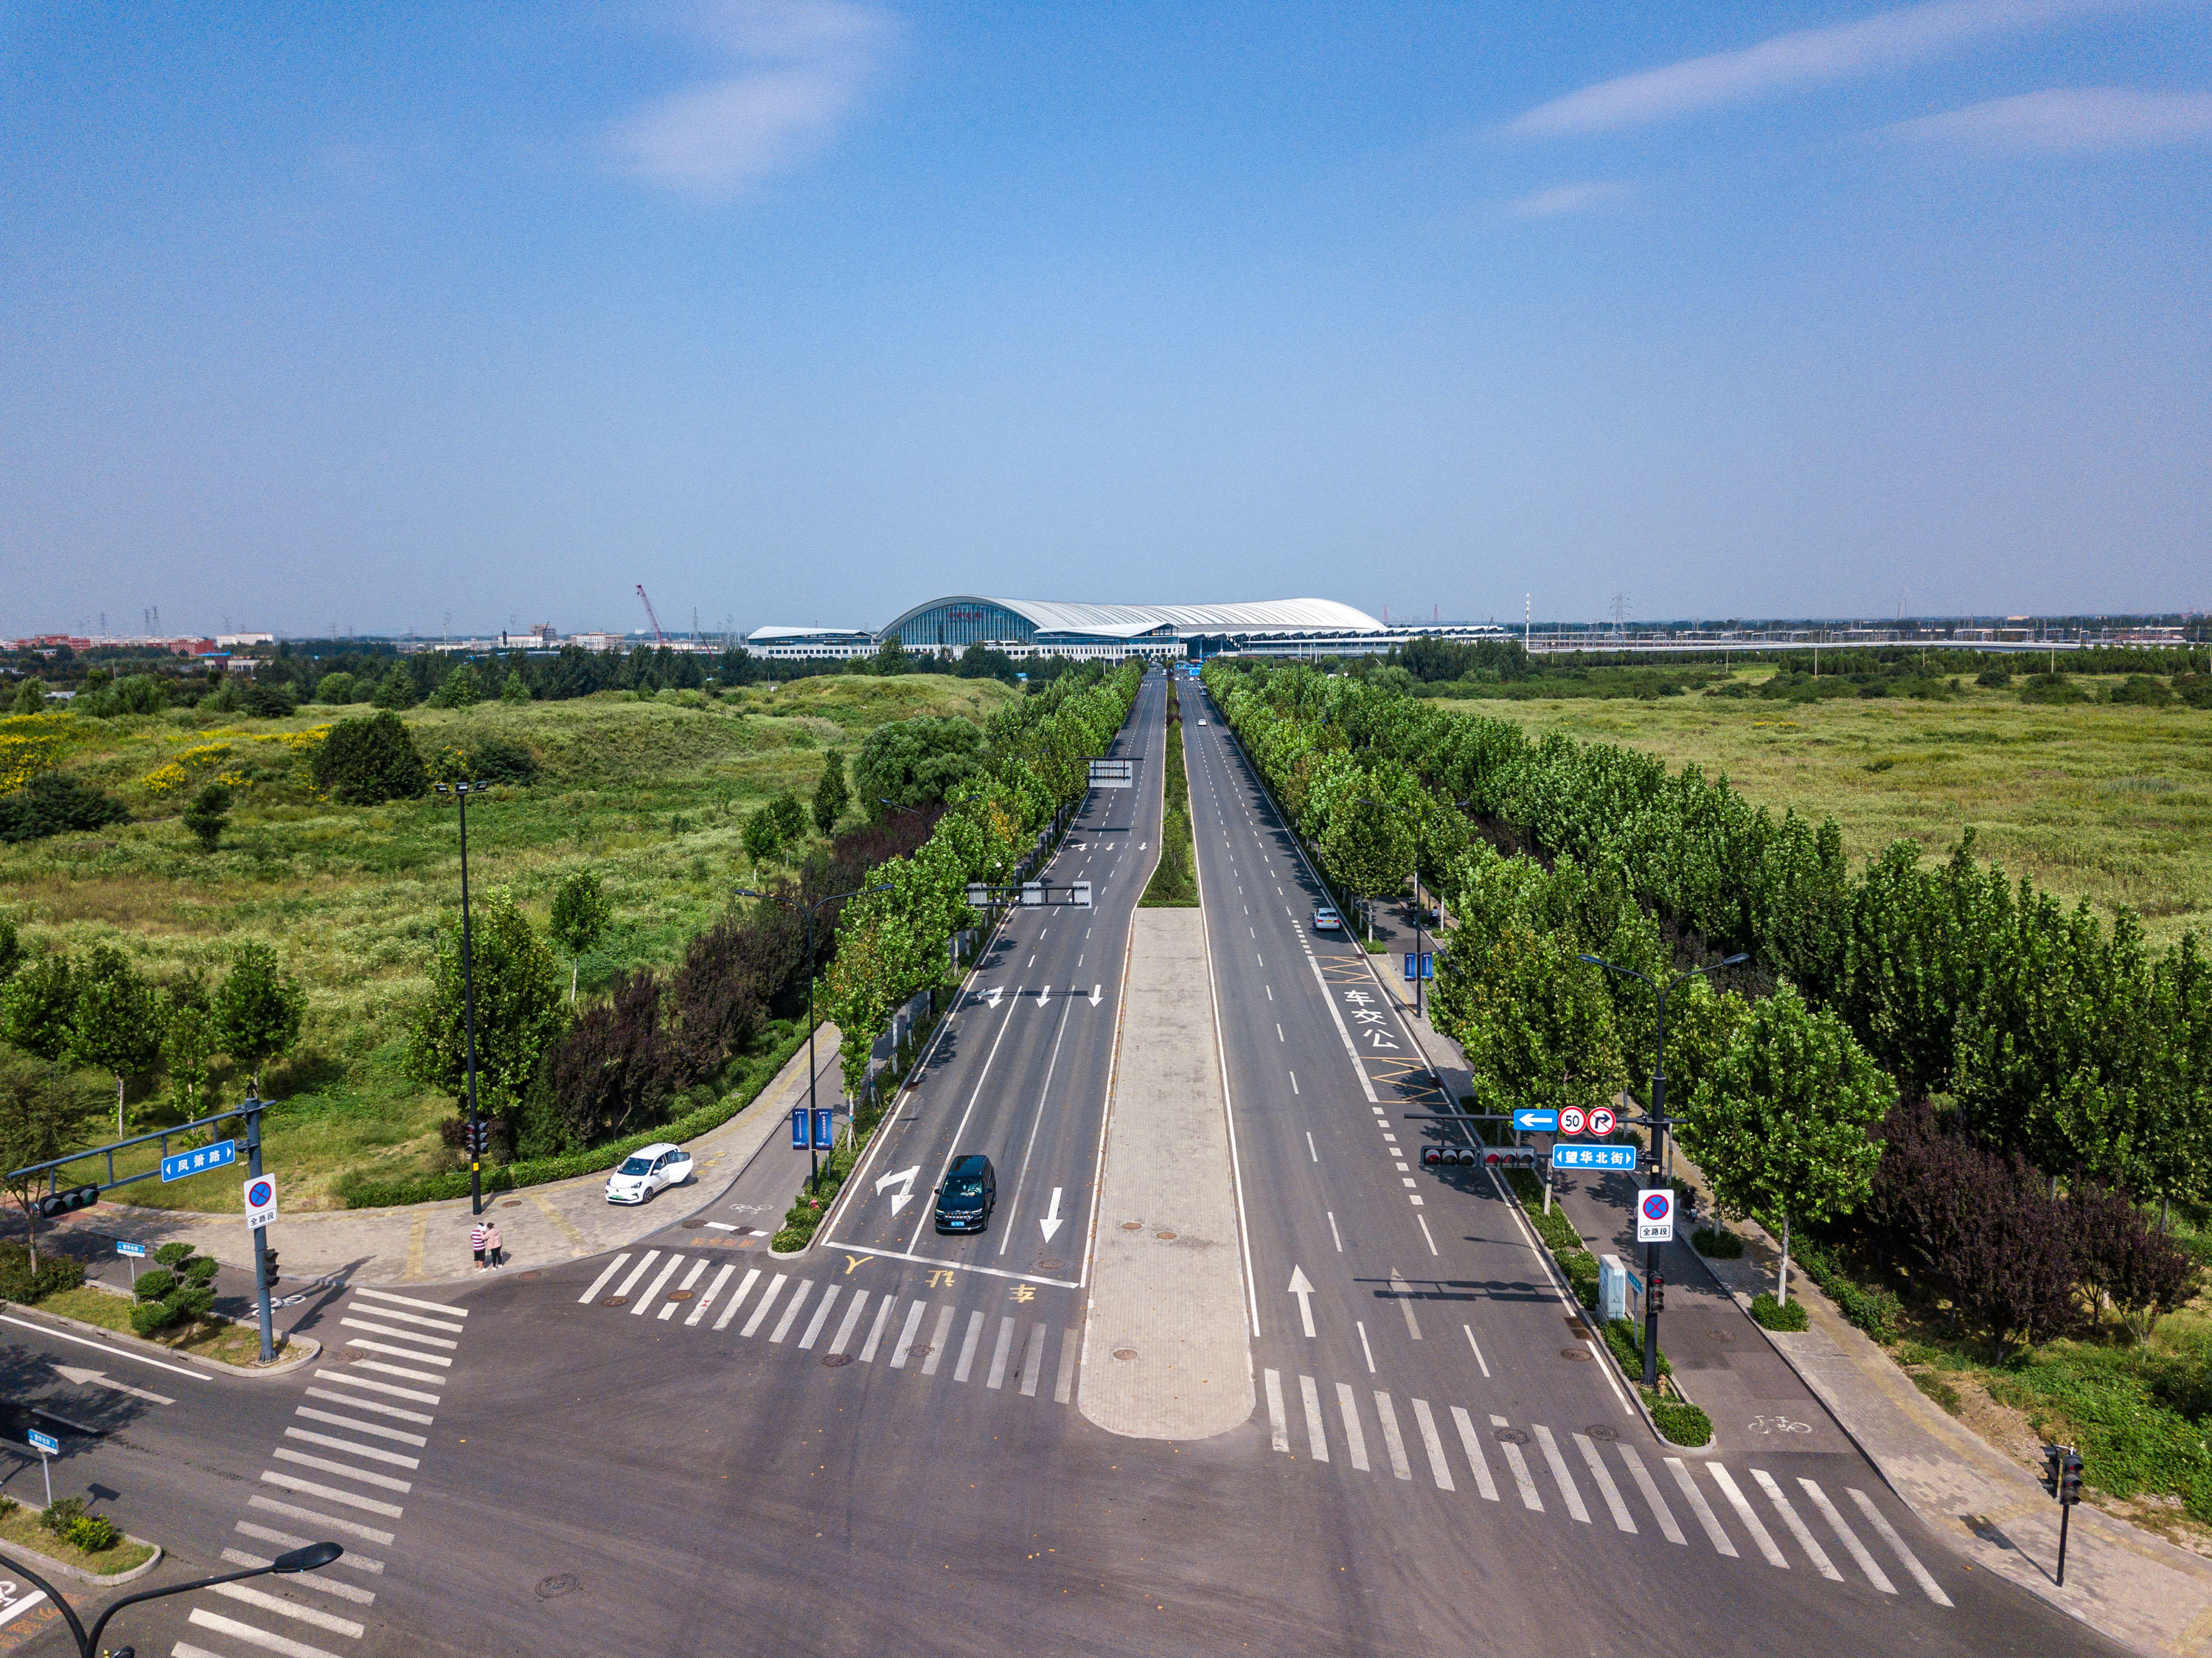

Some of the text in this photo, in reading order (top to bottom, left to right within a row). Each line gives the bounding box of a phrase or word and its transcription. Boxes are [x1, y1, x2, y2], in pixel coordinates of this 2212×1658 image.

[1565, 1115, 1579, 1127] 50
[1565, 1151, 1624, 1165] 望华北街
[251, 1212, 274, 1226] 全路段
[1643, 1227, 1668, 1236] 全路段
